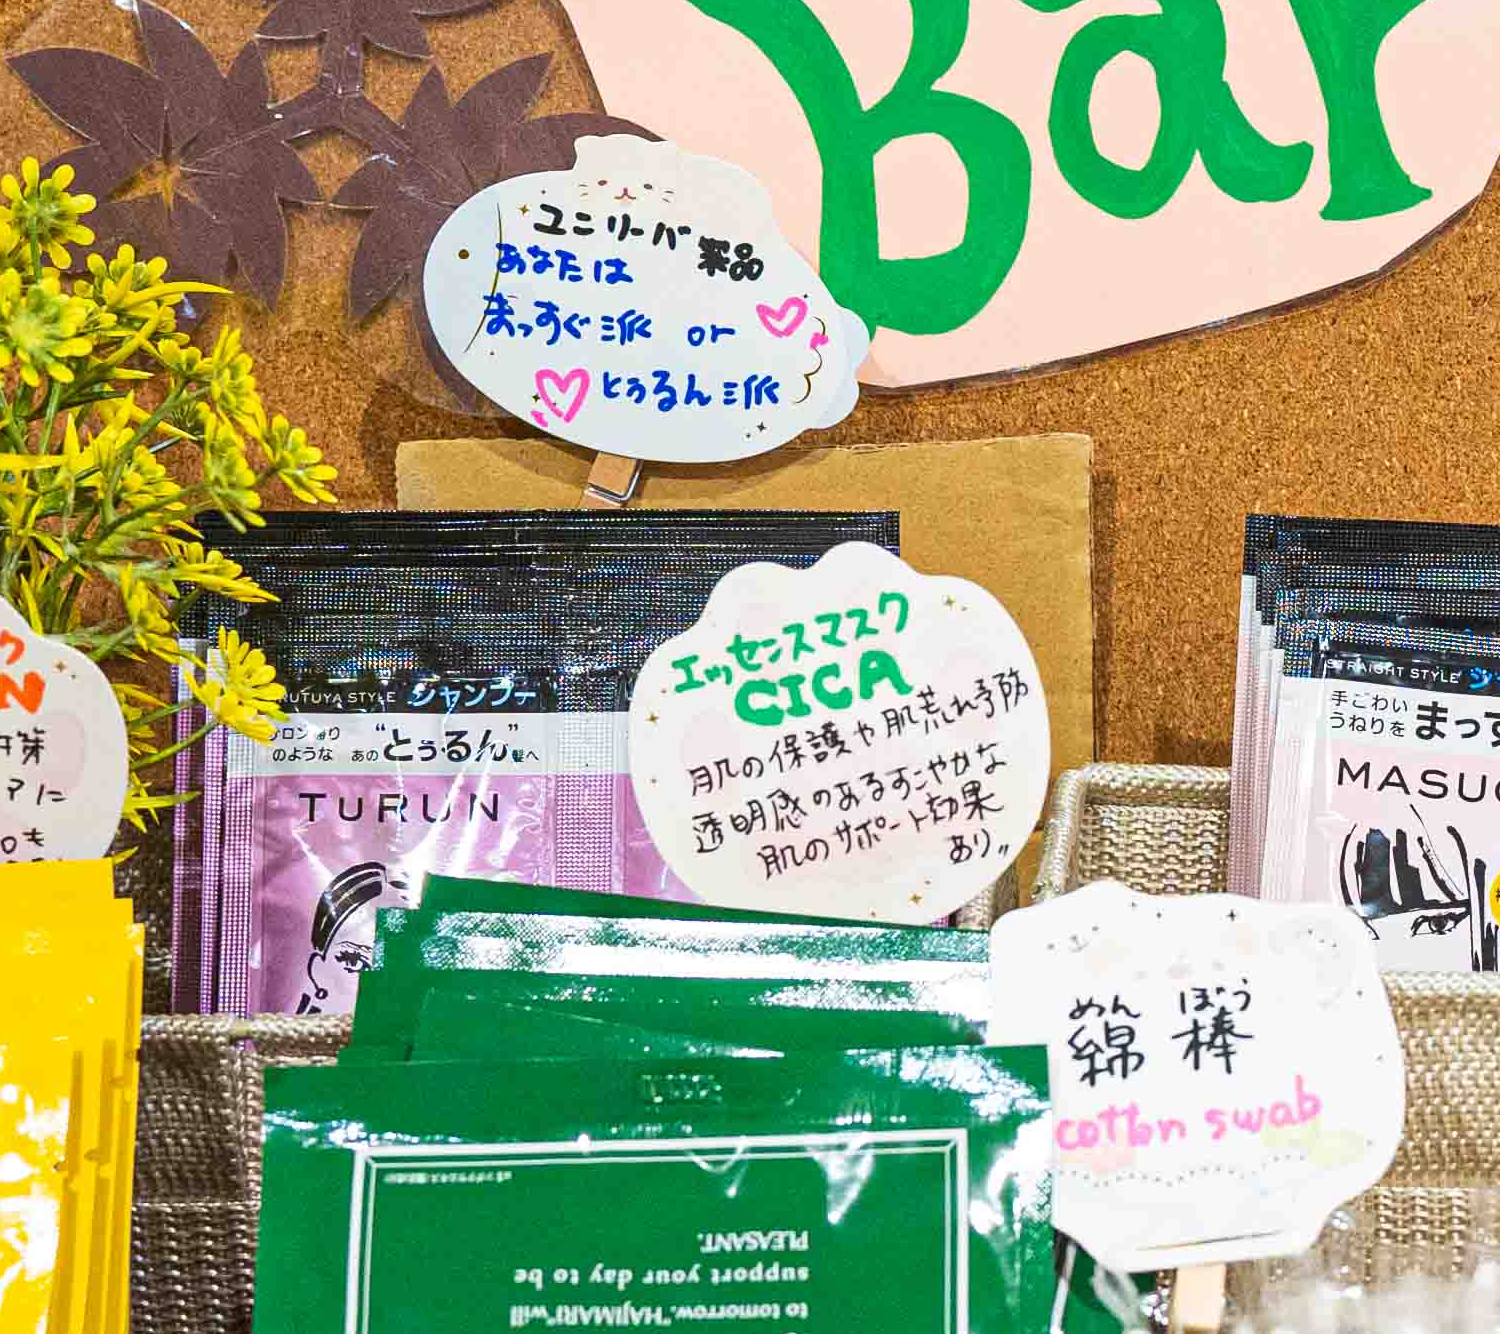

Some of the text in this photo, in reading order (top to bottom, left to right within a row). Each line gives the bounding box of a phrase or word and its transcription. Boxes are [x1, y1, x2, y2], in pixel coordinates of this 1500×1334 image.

[496, 243, 634, 284] あなたは
[483, 293, 735, 346] まっすぐ派 or
[671, 591, 910, 693] エッセンスマスク
[734, 650, 913, 726] CICA
[1410, 668, 1460, 683] STYLE
[348, 691, 396, 705] STYLE
[408, 676, 536, 708] シャンプー
[1331, 690, 1408, 712] 手ごわい
[1330, 712, 1405, 737] うねりを
[272, 747, 333, 762] のような
[299, 793, 499, 823] TURUN
[1068, 978, 1252, 1020] めん ぼう
[1204, 1075, 1322, 1140] swab
[697, 1231, 808, 1253] PLEASANT.
[514, 1262, 809, 1291] support your day to be
[786, 1303, 808, 1319] to
